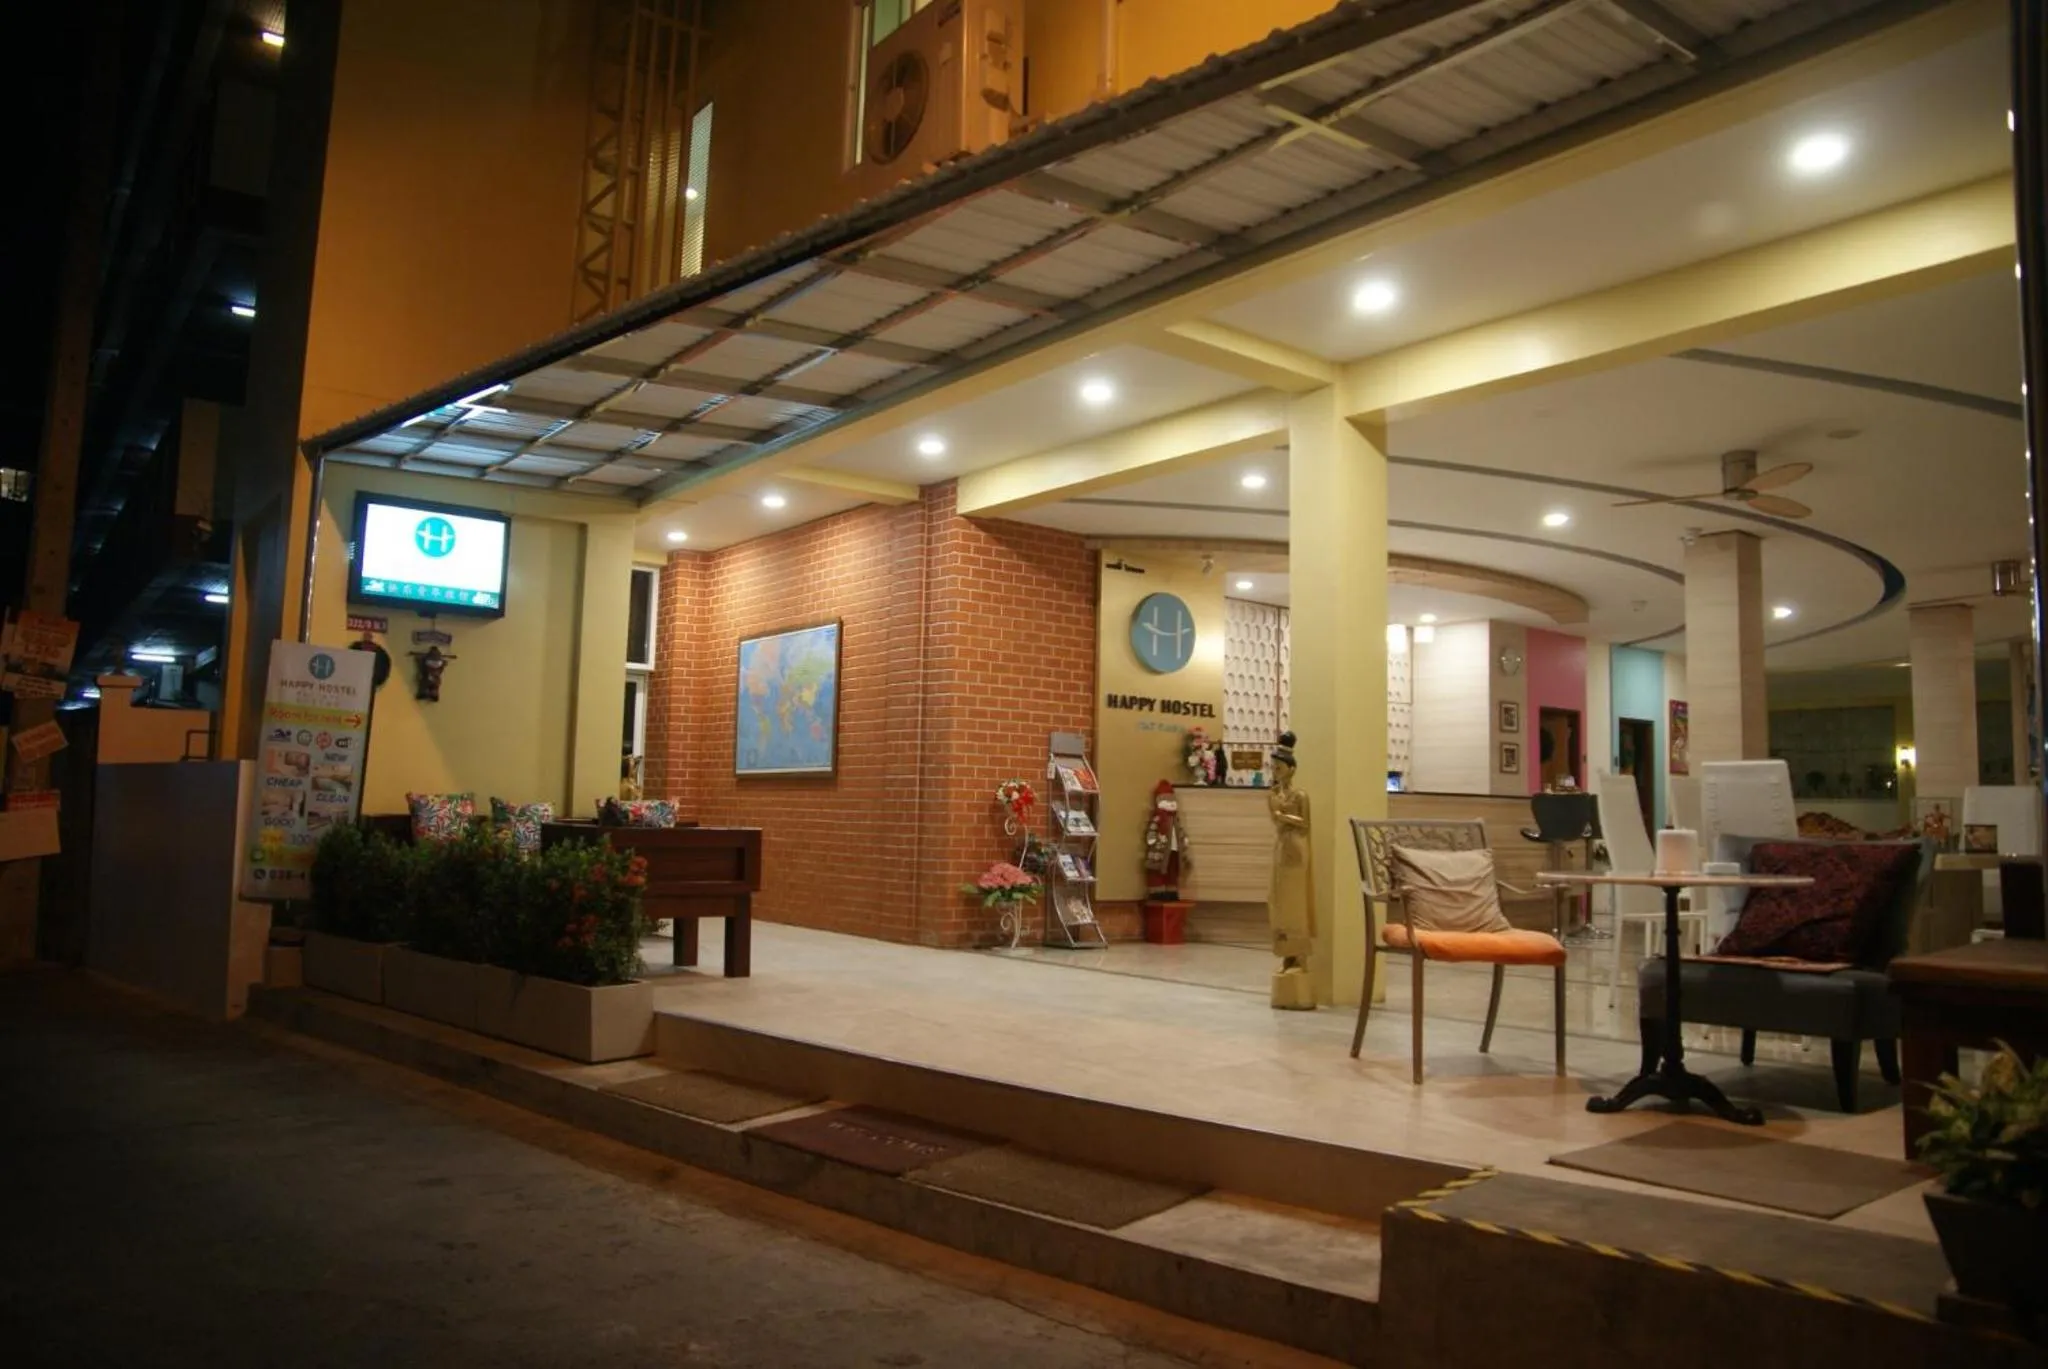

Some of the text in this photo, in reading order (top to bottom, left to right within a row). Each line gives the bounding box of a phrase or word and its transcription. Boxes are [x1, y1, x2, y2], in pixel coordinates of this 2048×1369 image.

[280, 679, 358, 697] HAPPY HOSTEL
[1107, 694, 1216, 718] HAPPY HOSTEL
[266, 776, 304, 789] CHEAP
[315, 792, 350, 804] CLEAN
